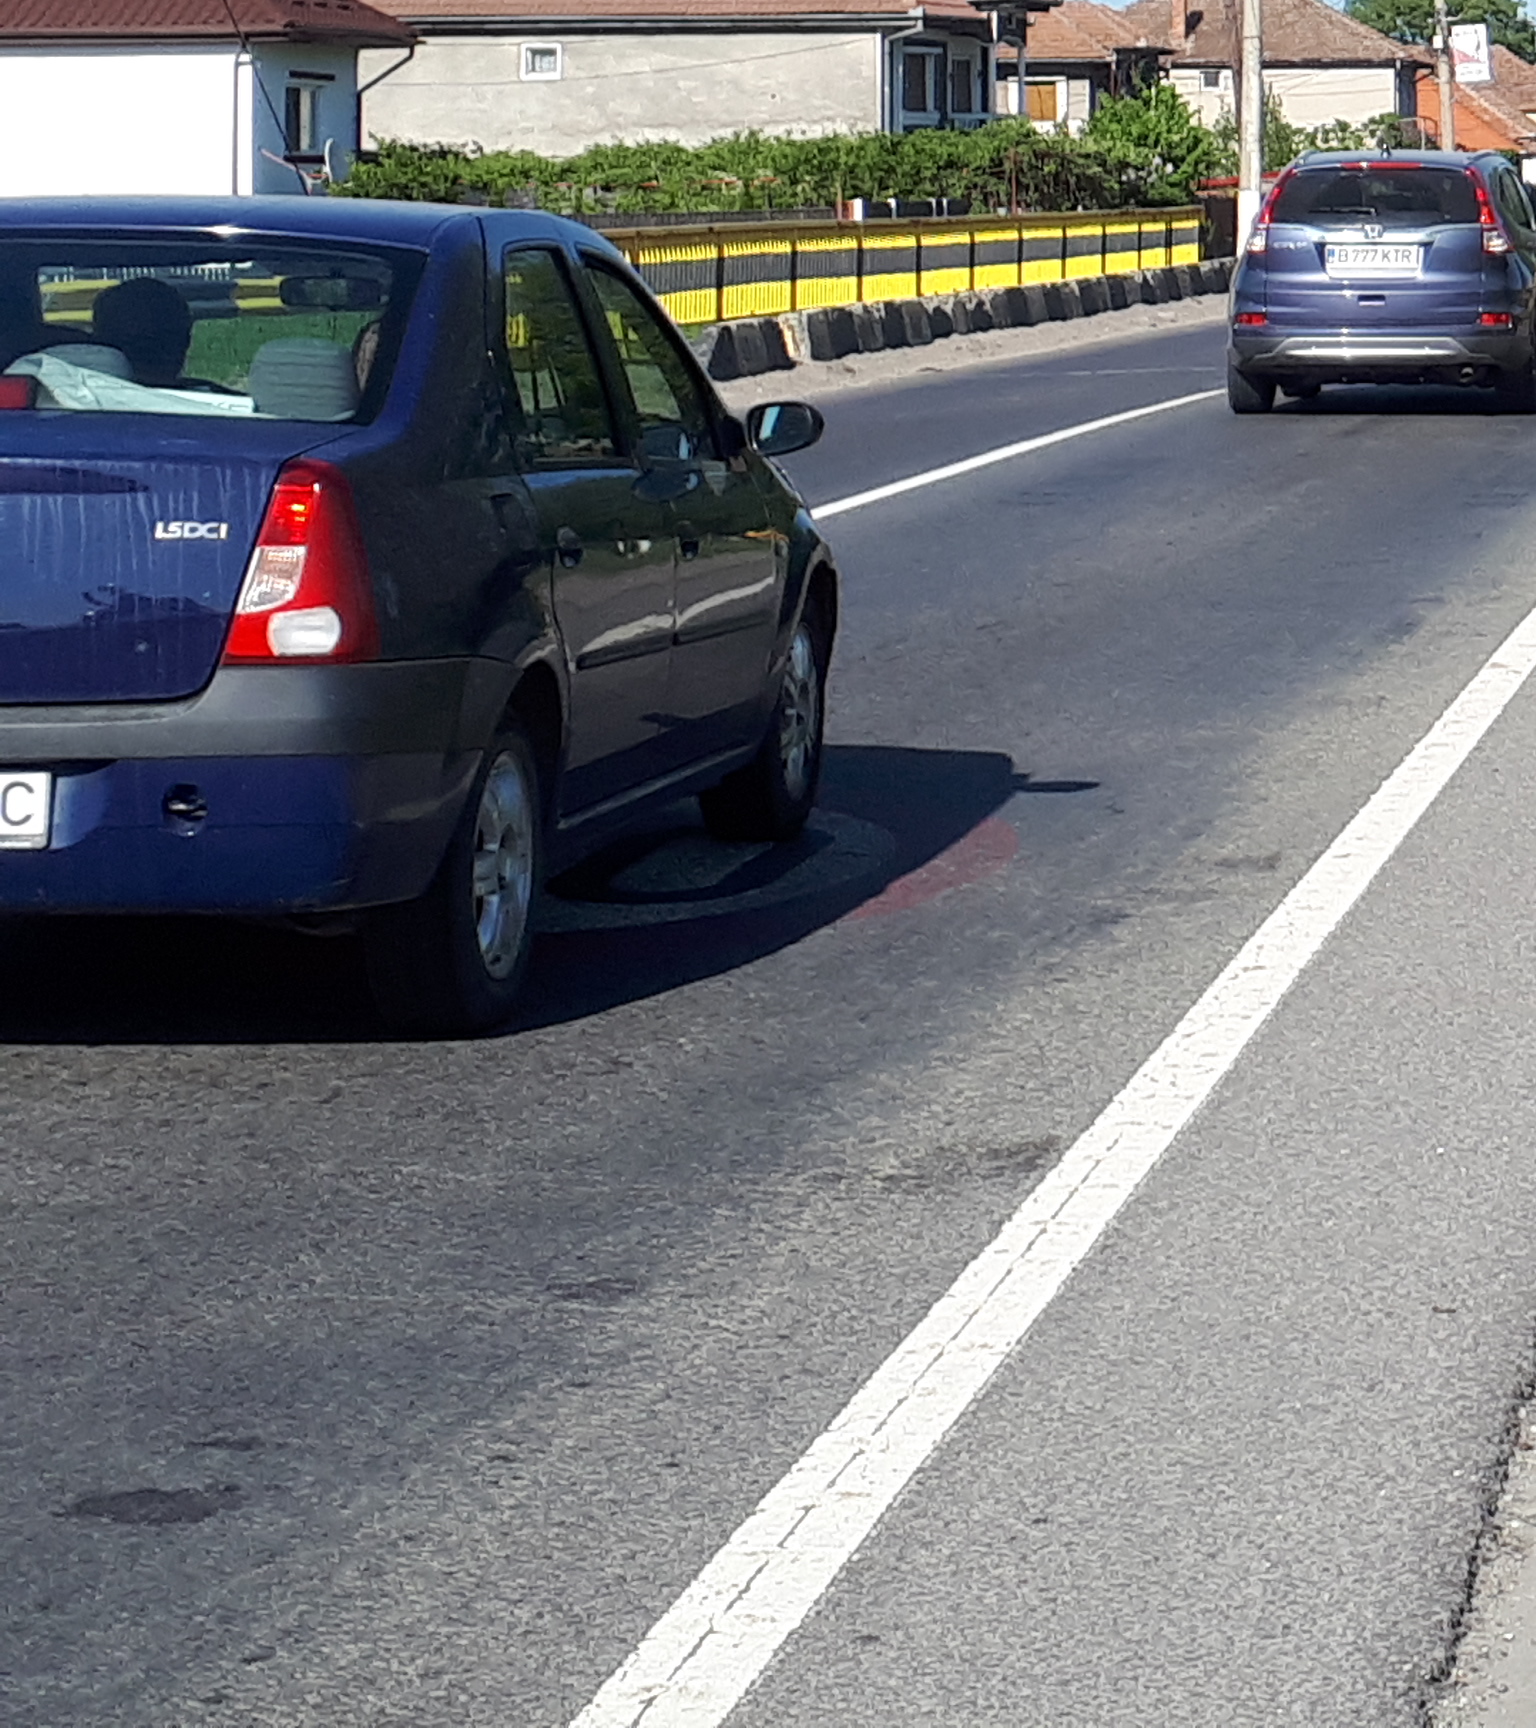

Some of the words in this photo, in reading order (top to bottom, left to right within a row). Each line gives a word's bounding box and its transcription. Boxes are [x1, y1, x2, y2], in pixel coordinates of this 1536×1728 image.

[1338, 248, 1348, 263] B
[1352, 248, 1378, 263] 777
[1381, 248, 1412, 263] KTR
